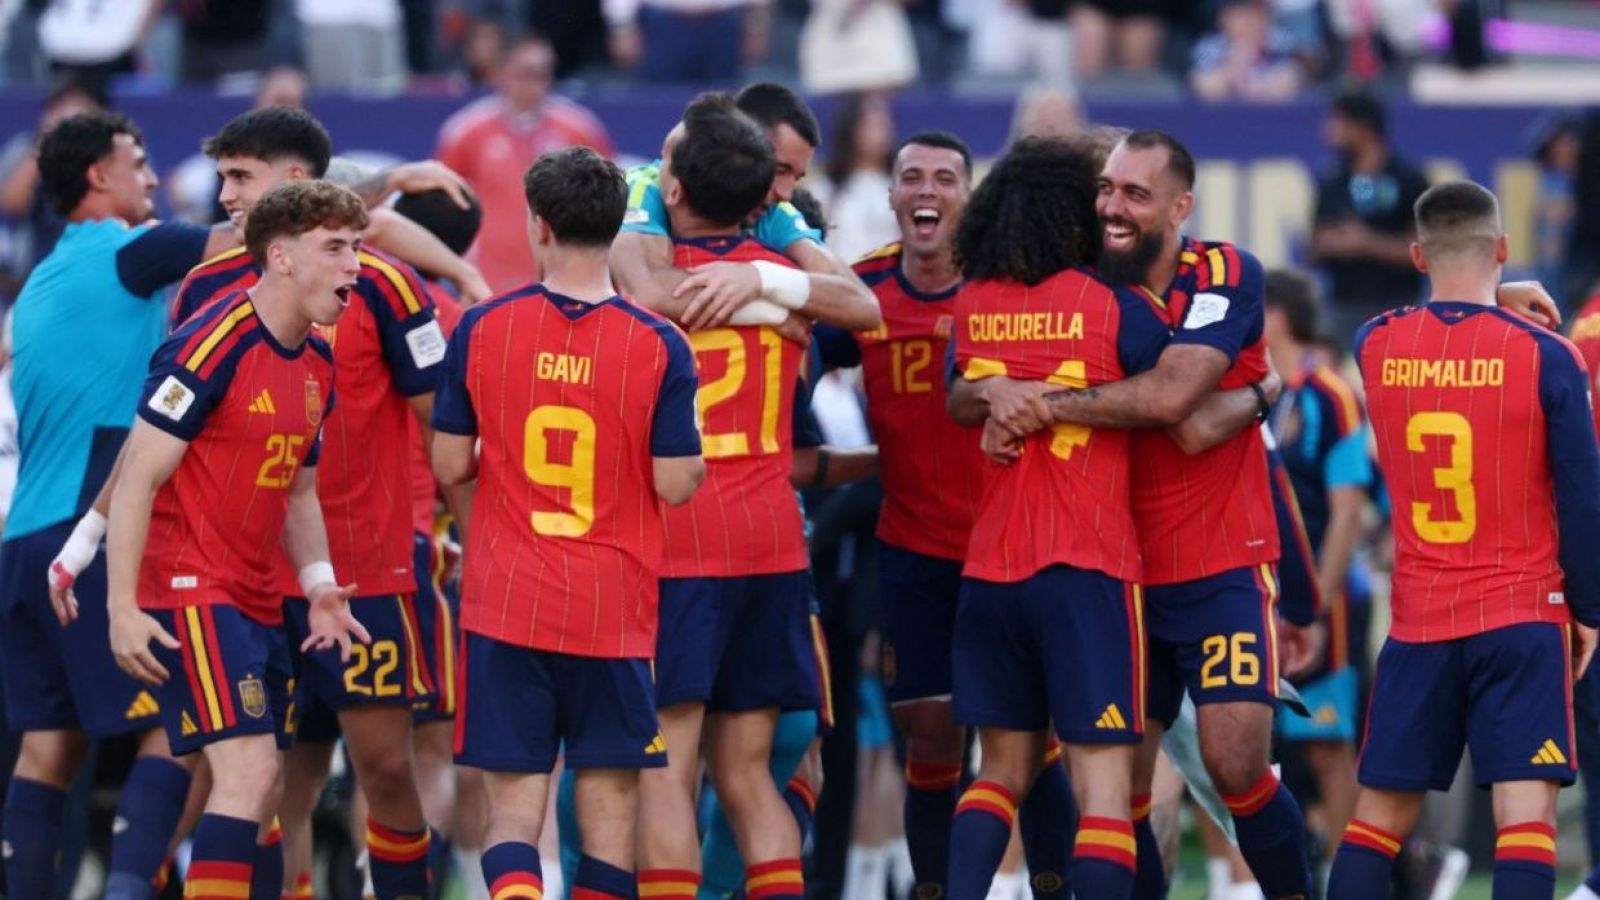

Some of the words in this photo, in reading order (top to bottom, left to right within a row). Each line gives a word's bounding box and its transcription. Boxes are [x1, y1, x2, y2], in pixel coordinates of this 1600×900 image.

[968, 312, 1084, 341] CUCURELLA
[536, 352, 591, 385] GAVI
[688, 326, 782, 458] 21
[890, 340, 932, 393] 12
[1382, 358, 1504, 387] GRIMALDO
[256, 434, 304, 488] 25
[524, 405, 596, 537] 9
[1406, 411, 1476, 543] 3
[343, 640, 401, 696] 22
[1201, 632, 1260, 688] 26
